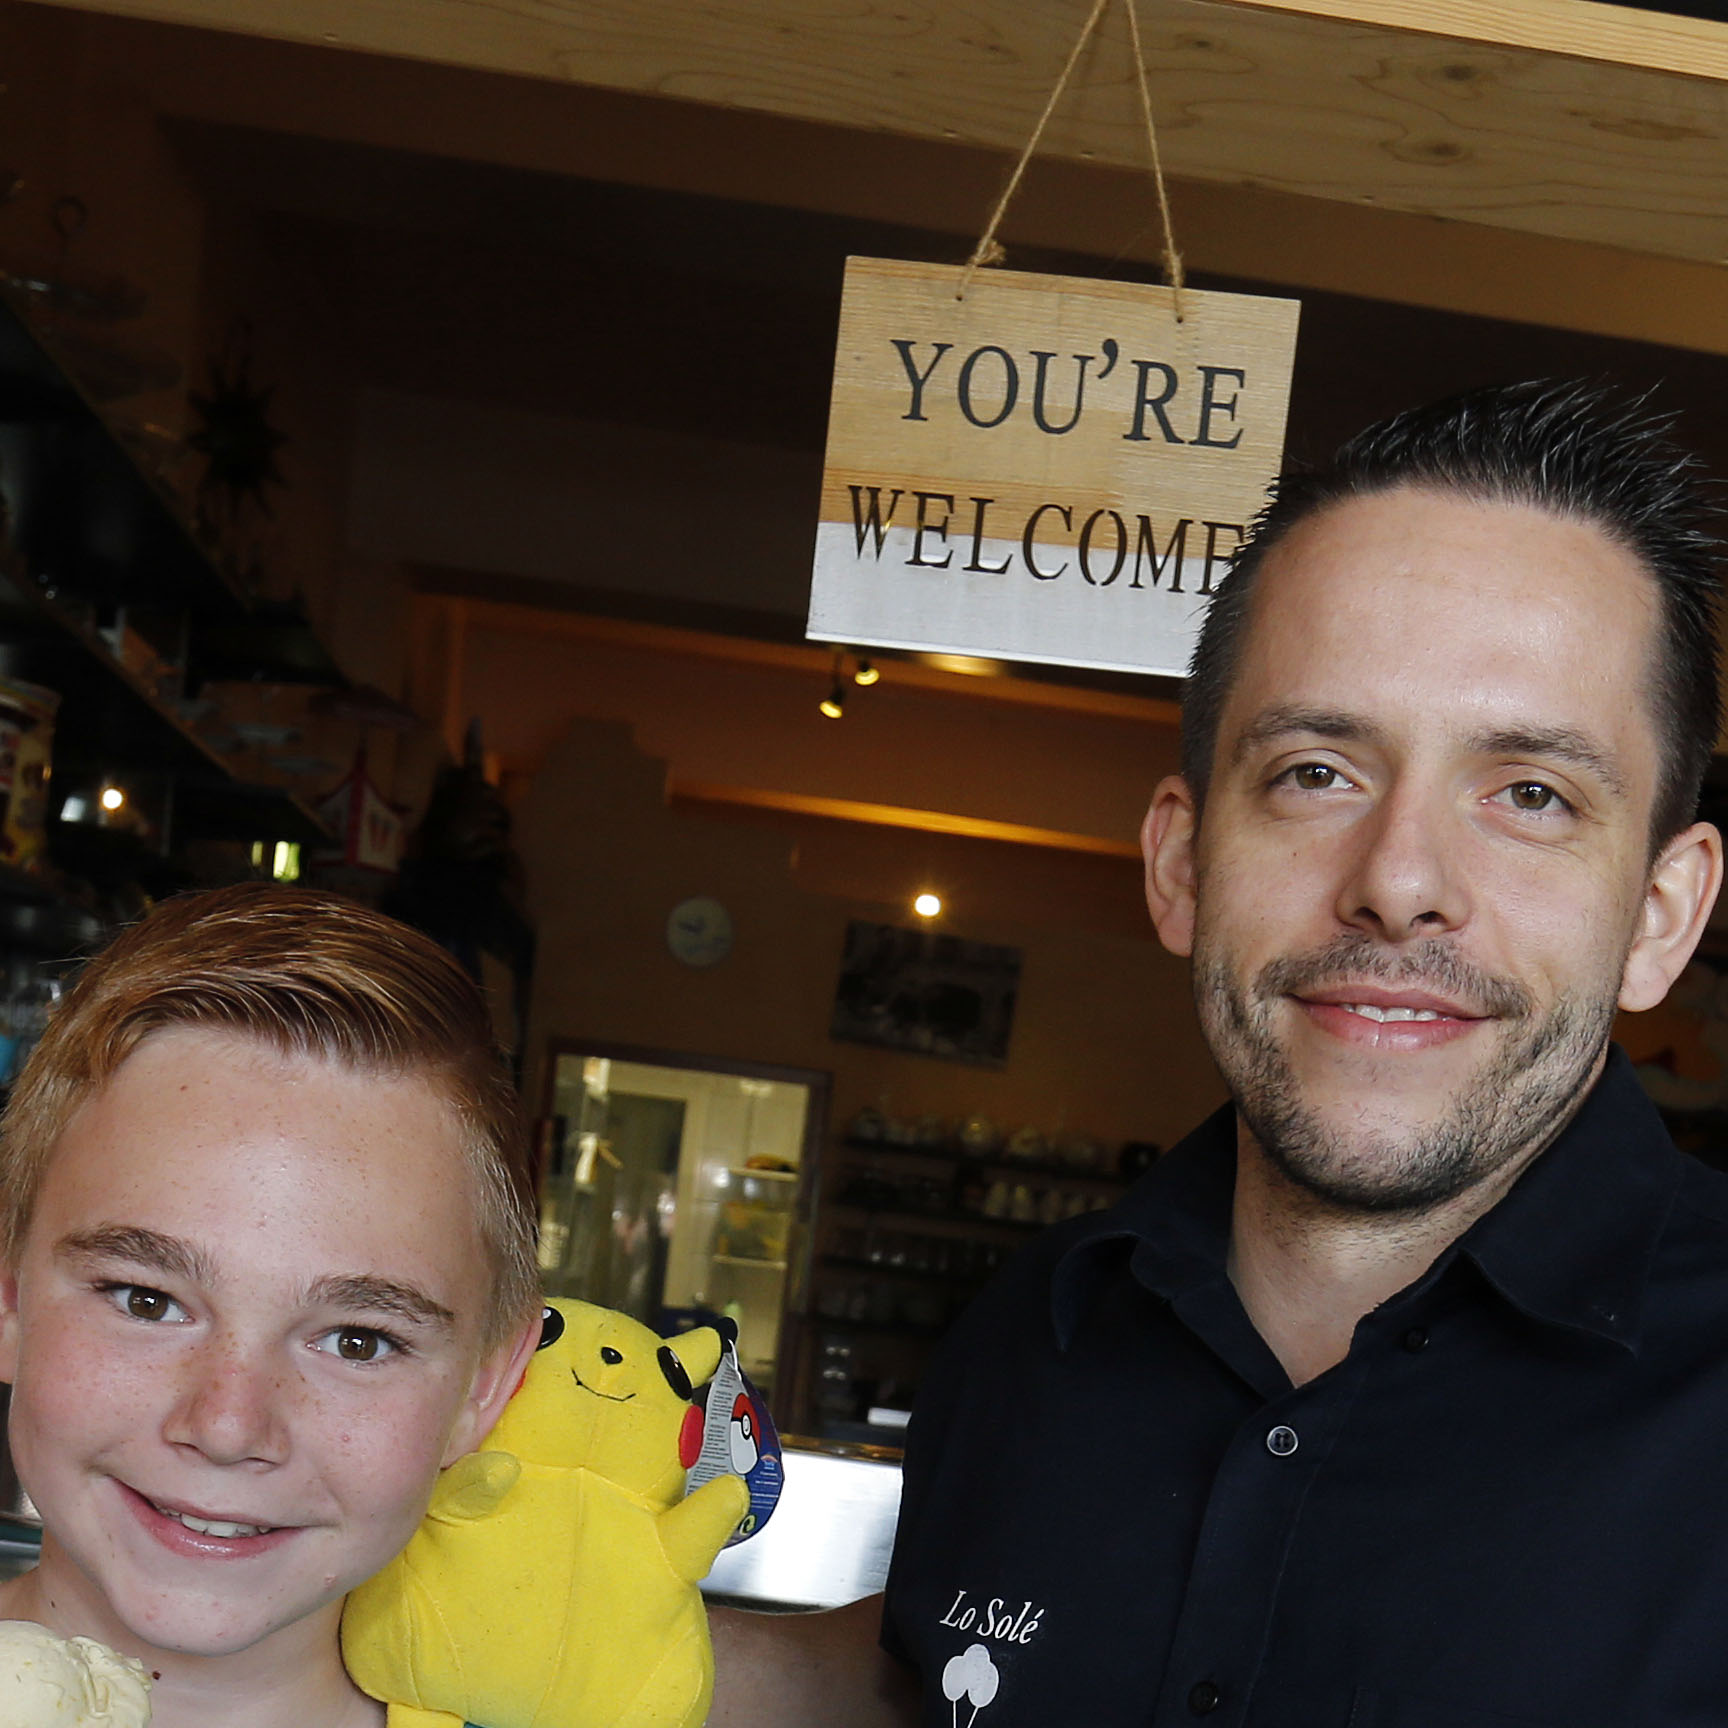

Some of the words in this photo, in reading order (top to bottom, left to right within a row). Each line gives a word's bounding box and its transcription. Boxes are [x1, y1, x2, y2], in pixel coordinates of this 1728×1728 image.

[890, 338, 1246, 450] YOU'RE
[847, 484, 1245, 596] WELCOME
[939, 1590, 976, 1630] Lo
[976, 1598, 1044, 1644] Solé
